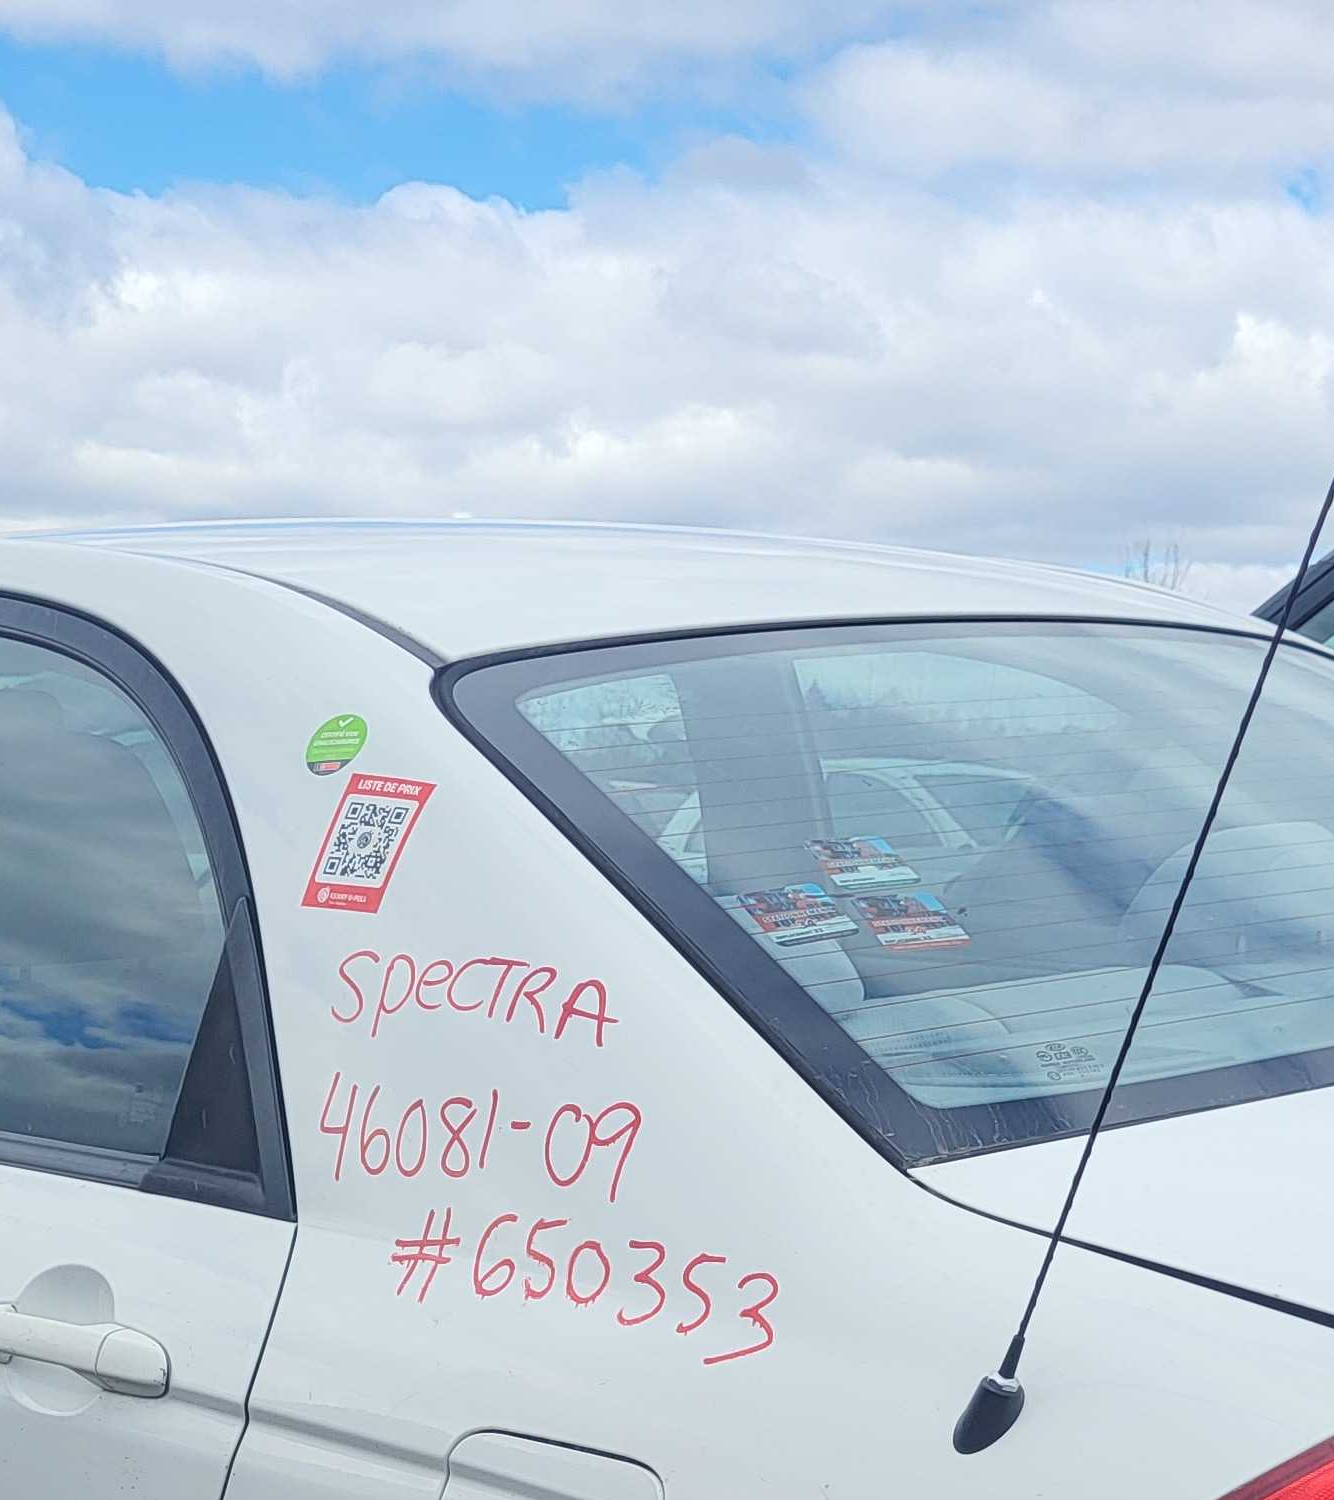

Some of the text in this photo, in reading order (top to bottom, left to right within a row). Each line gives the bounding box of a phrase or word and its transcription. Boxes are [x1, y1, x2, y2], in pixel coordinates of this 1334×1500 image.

[357, 779, 423, 797] LISTE DE PRIX
[319, 1071, 643, 1203] 46081-09
[389, 1206, 780, 1366] #650353
